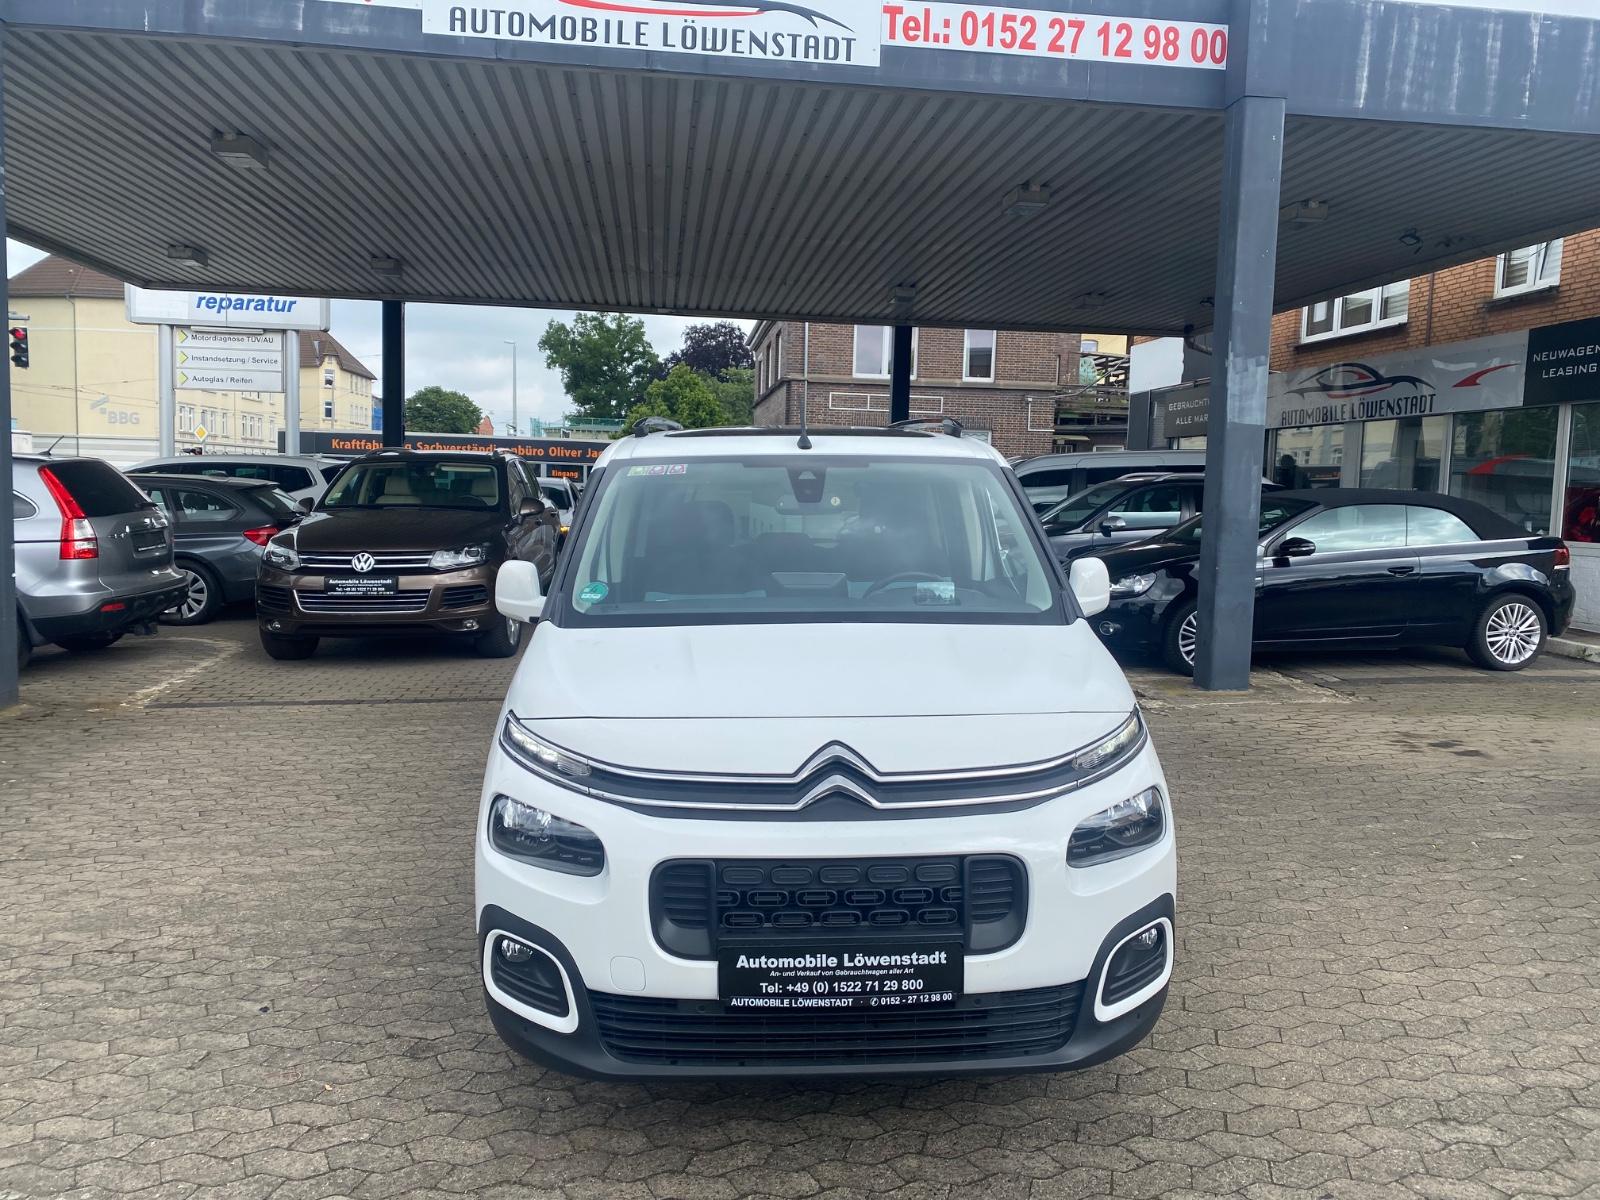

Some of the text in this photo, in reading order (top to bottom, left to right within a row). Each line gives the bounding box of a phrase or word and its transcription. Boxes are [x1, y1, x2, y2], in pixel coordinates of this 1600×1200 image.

[449, 6, 857, 62] AUTOMOBILE LÖWENSTADT
[882, 5, 1227, 65] Tel.: 0152 27 12 98 00
[196, 295, 297, 314] reparatur
[191, 334, 245, 343] Motordiagnose
[191, 354, 246, 364] Instandsetzung
[251, 357, 278, 365] Service
[1542, 363, 1598, 379] LEASING
[192, 375, 224, 385] Autoglas
[229, 376, 253, 384] Reifen
[107, 410, 141, 425] BBG
[1281, 393, 1437, 427] AUTOMOBILE LÖWENSTADT
[1175, 415, 1193, 425] ALLE
[548, 446, 582, 458] Oliver
[551, 469, 579, 479] Eingang
[736, 951, 947, 968] Automobile Löwenstadt
[760, 979, 924, 995] Tel: +49 (0) 1522 71 29 800
[731, 998, 790, 1007] AUTOMOBILE
[792, 998, 854, 1007] LÖWENSTADT
[880, 997, 901, 1005] 0152
[907, 995, 917, 1004] 27
[920, 994, 929, 1003] 12
[930, 994, 941, 1003] 98
[942, 992, 953, 1001] 00
